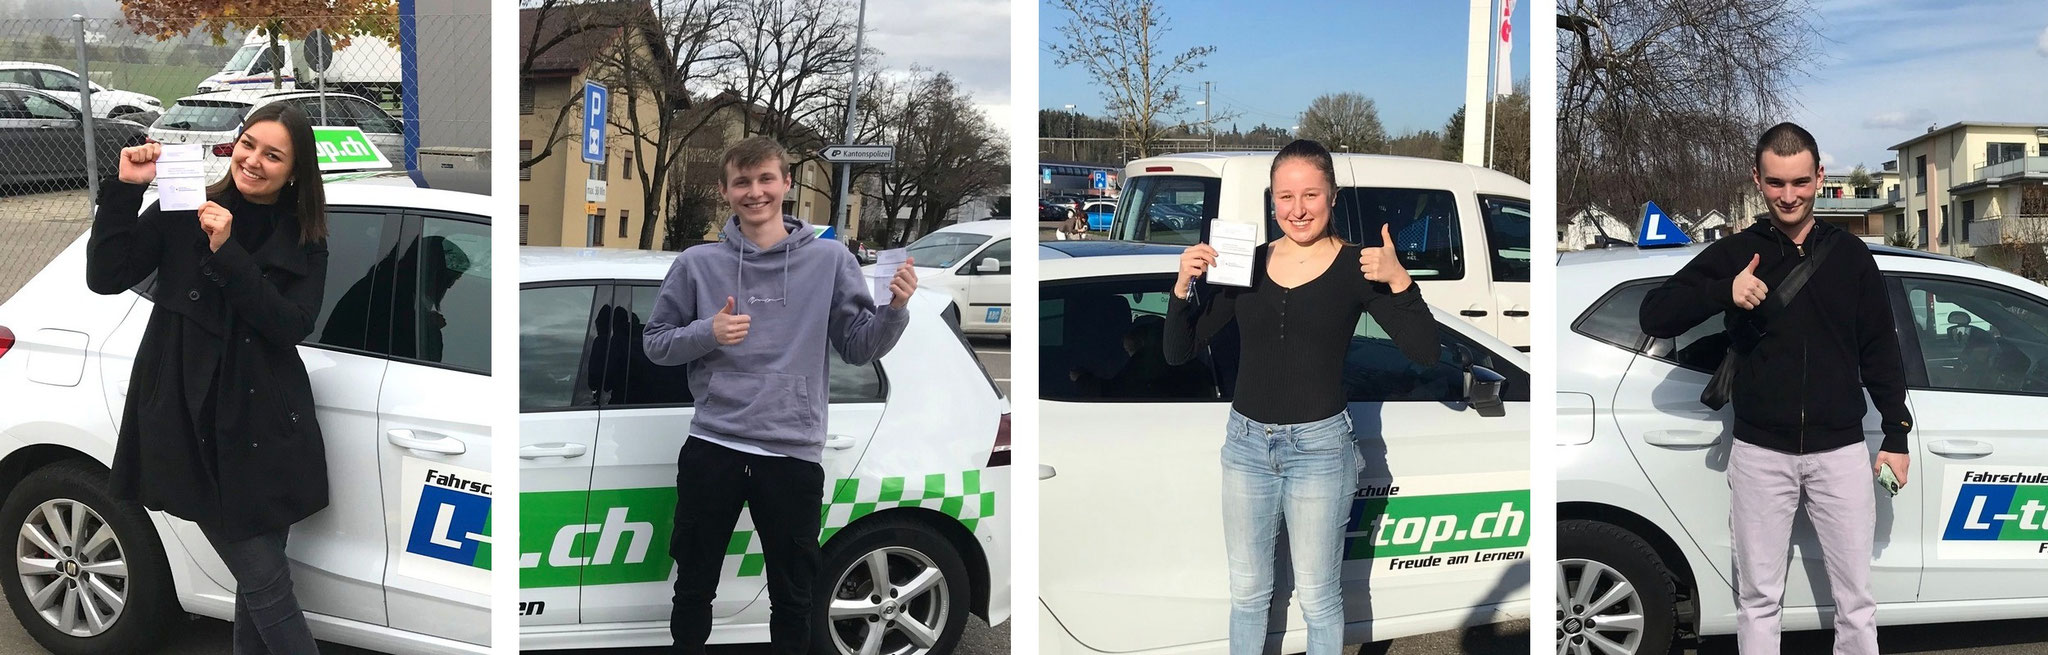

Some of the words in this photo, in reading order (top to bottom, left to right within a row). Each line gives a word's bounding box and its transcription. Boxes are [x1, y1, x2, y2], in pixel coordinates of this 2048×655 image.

[591, 91, 601, 126] P
[843, 150, 890, 158] Kantonspolizei
[1646, 214, 1667, 240] L
[425, 469, 492, 496] Fahrsc
[1963, 471, 2048, 484] Fahrschule
[1389, 555, 1441, 570] Freude
[1447, 554, 1469, 565] am
[1474, 550, 1524, 563] Lernen
